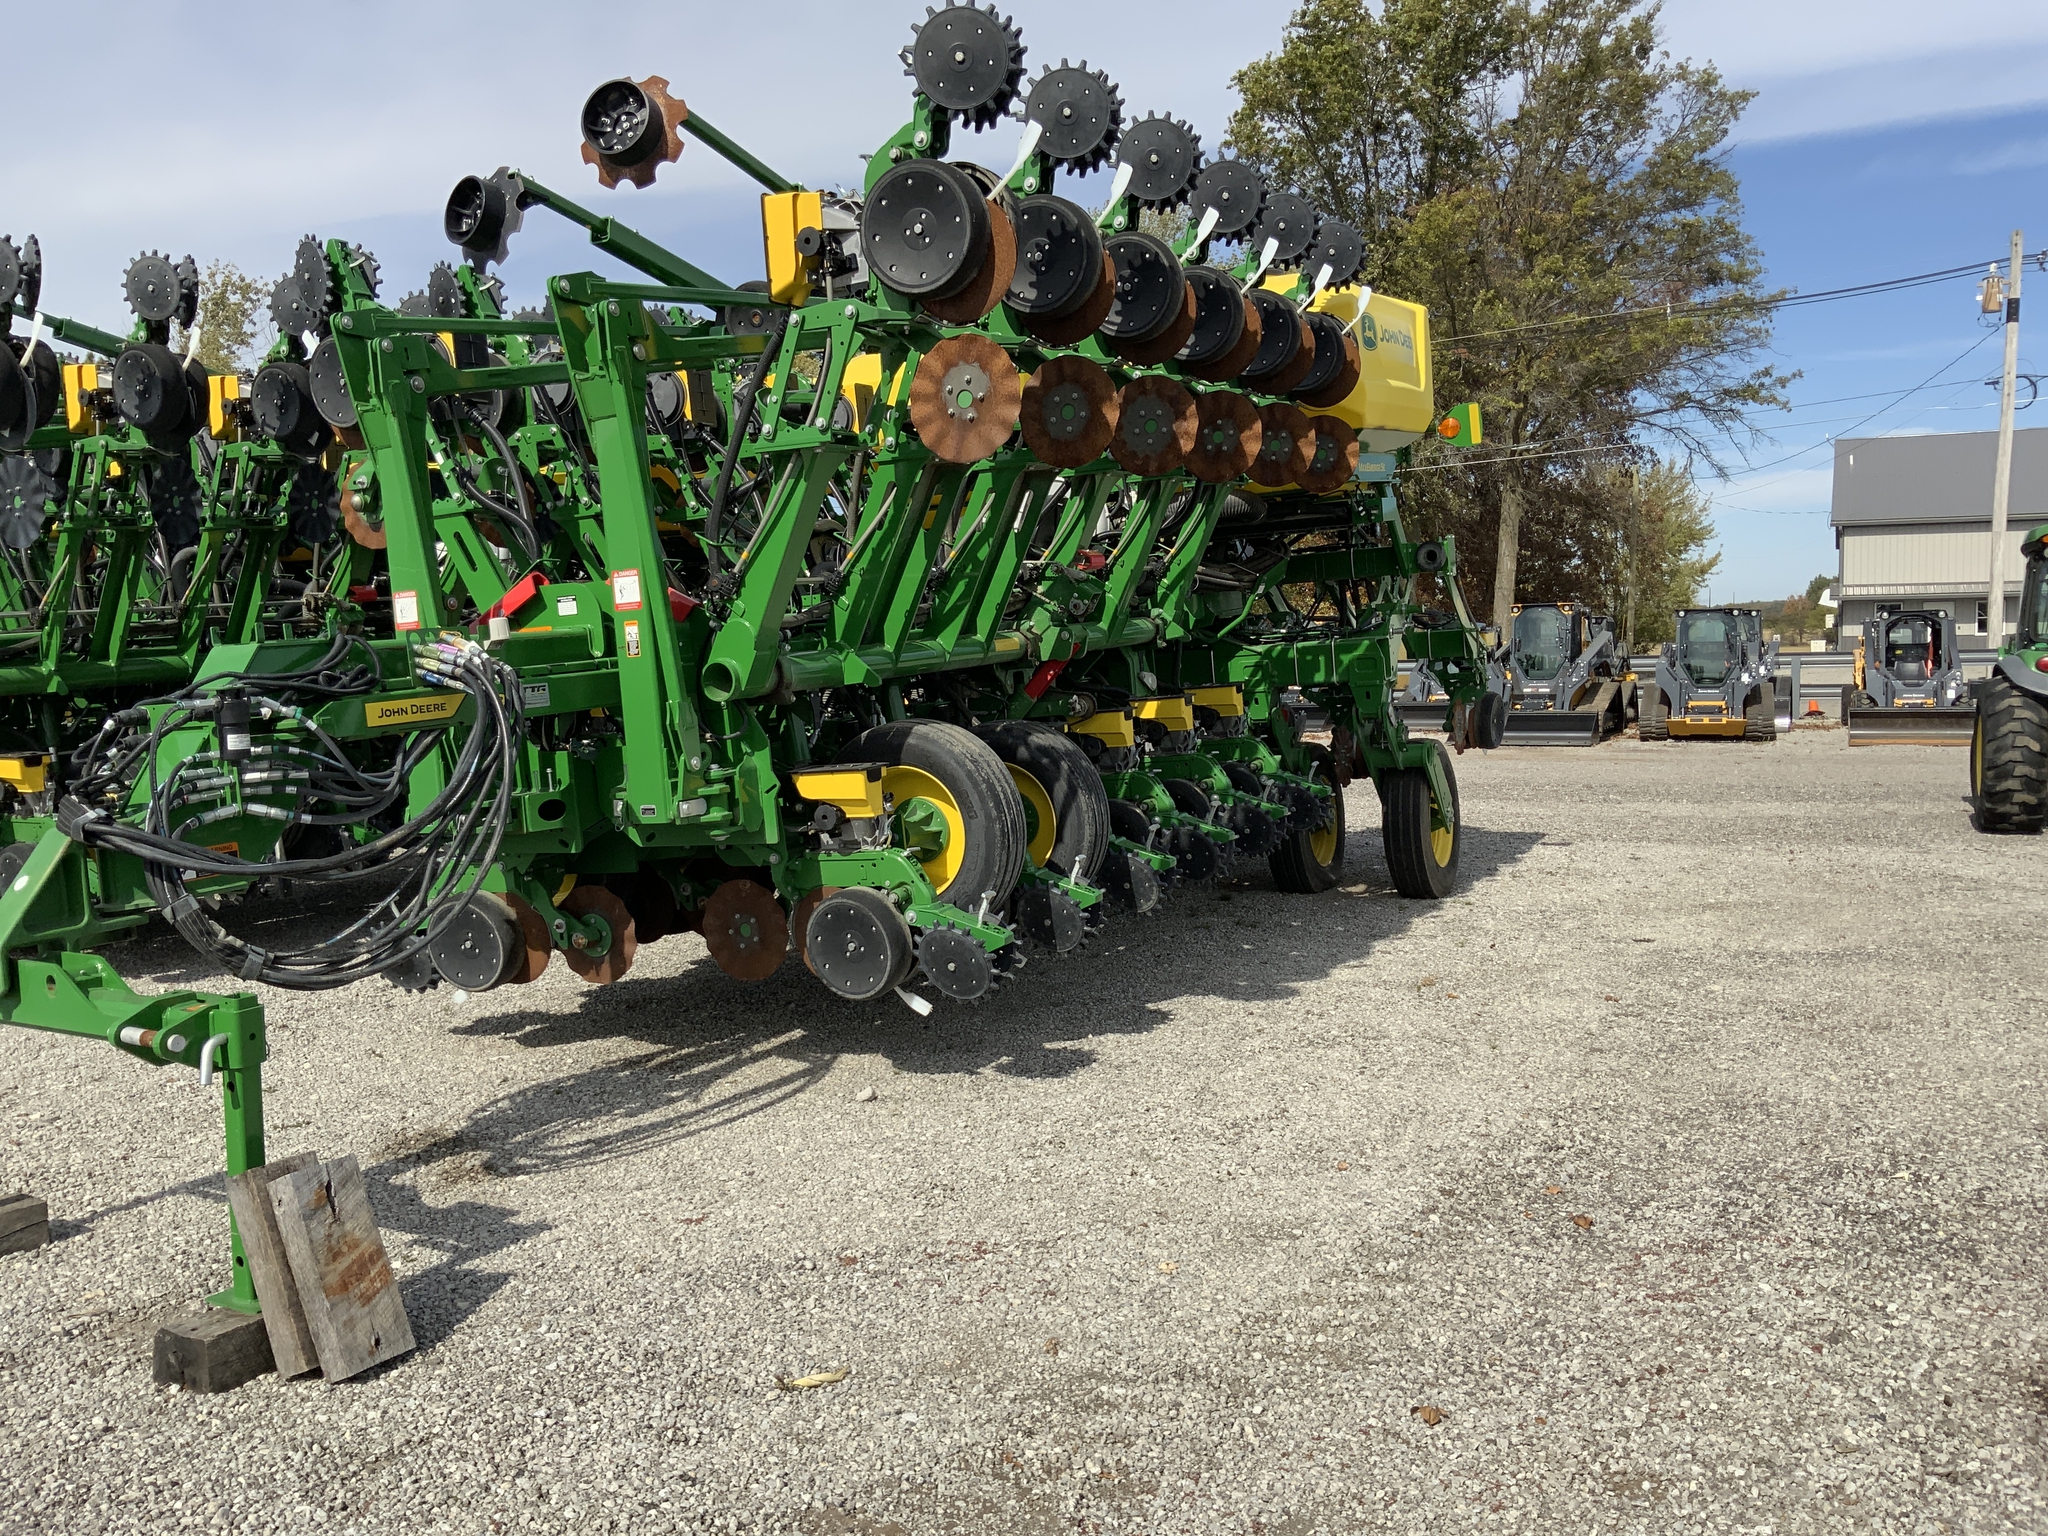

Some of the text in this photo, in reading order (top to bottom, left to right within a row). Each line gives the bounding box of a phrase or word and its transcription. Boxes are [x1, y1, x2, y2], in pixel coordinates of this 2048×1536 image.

[1380, 324, 1400, 346] JOHN
[618, 569, 638, 577] DANGER
[378, 702, 447, 719] JOHN DEERE
[210, 844, 233, 853] ARNING
